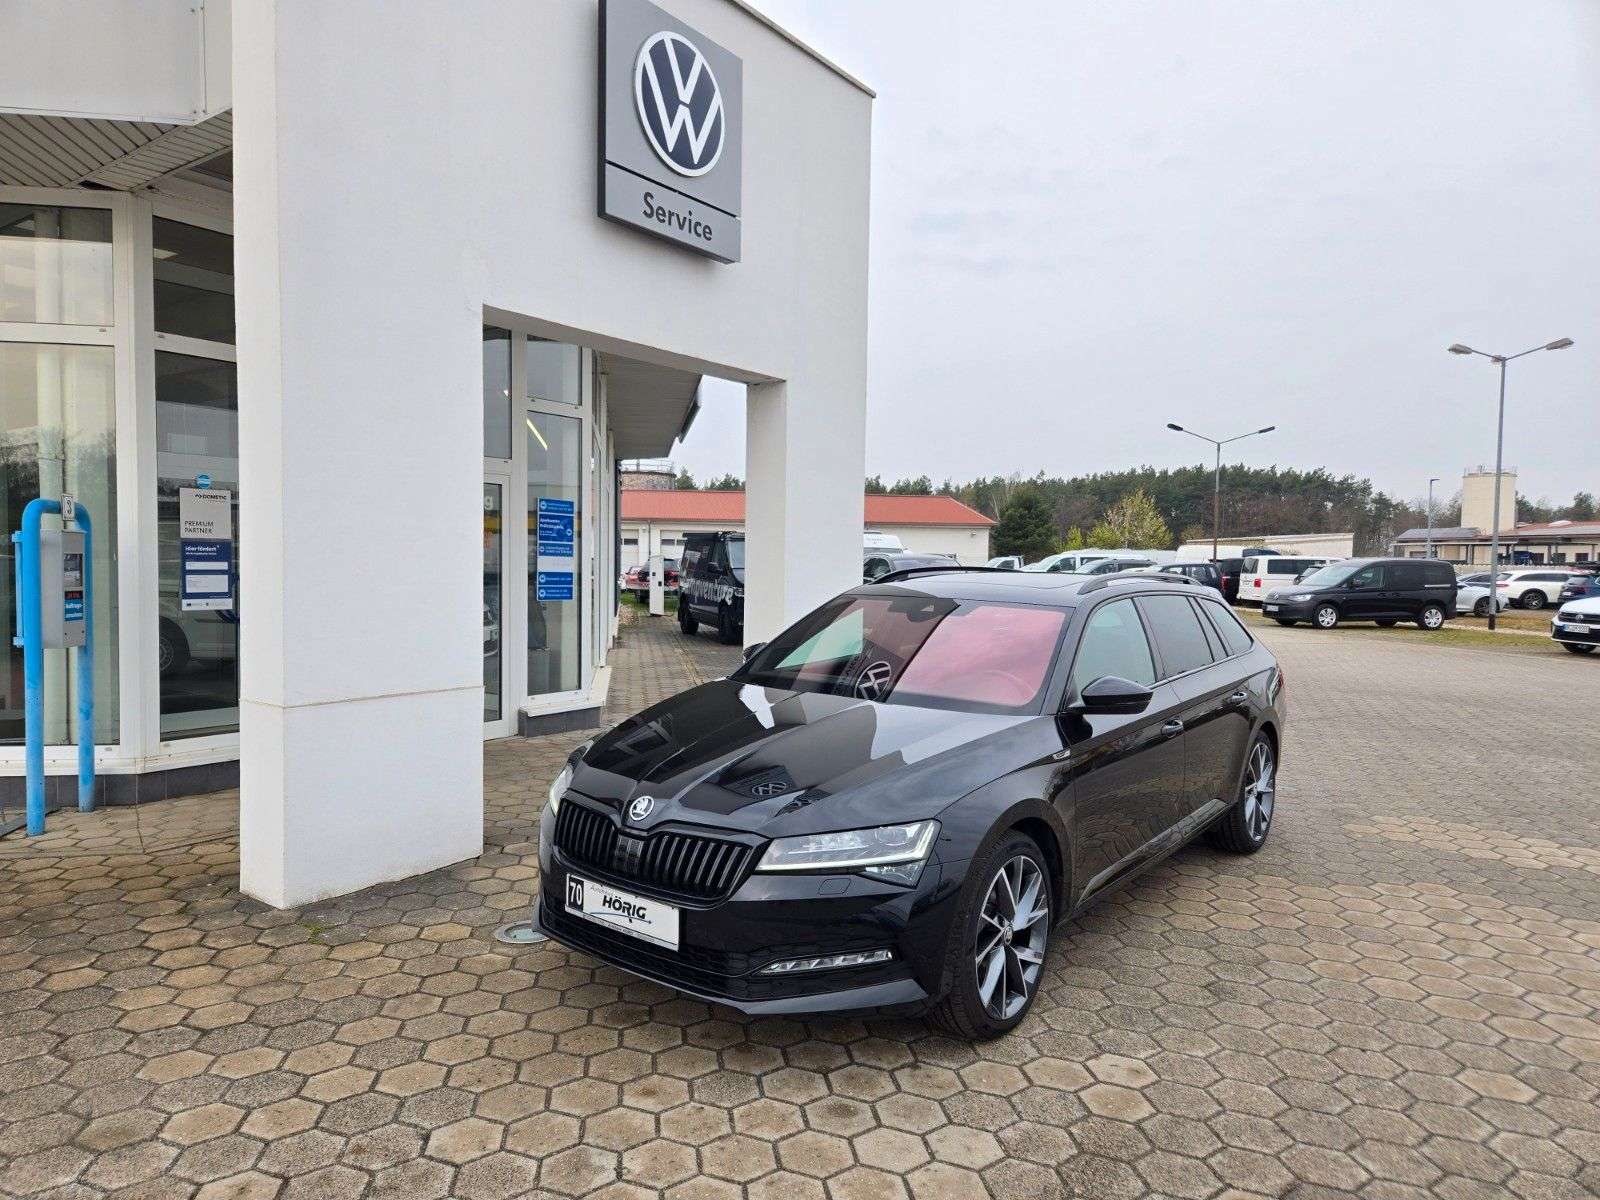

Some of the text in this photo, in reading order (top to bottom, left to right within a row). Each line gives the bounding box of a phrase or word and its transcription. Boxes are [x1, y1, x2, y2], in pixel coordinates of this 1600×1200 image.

[635, 31, 725, 177] VW
[642, 191, 713, 242] Service
[569, 881, 583, 906] 70
[602, 894, 647, 923] HÖRIG
